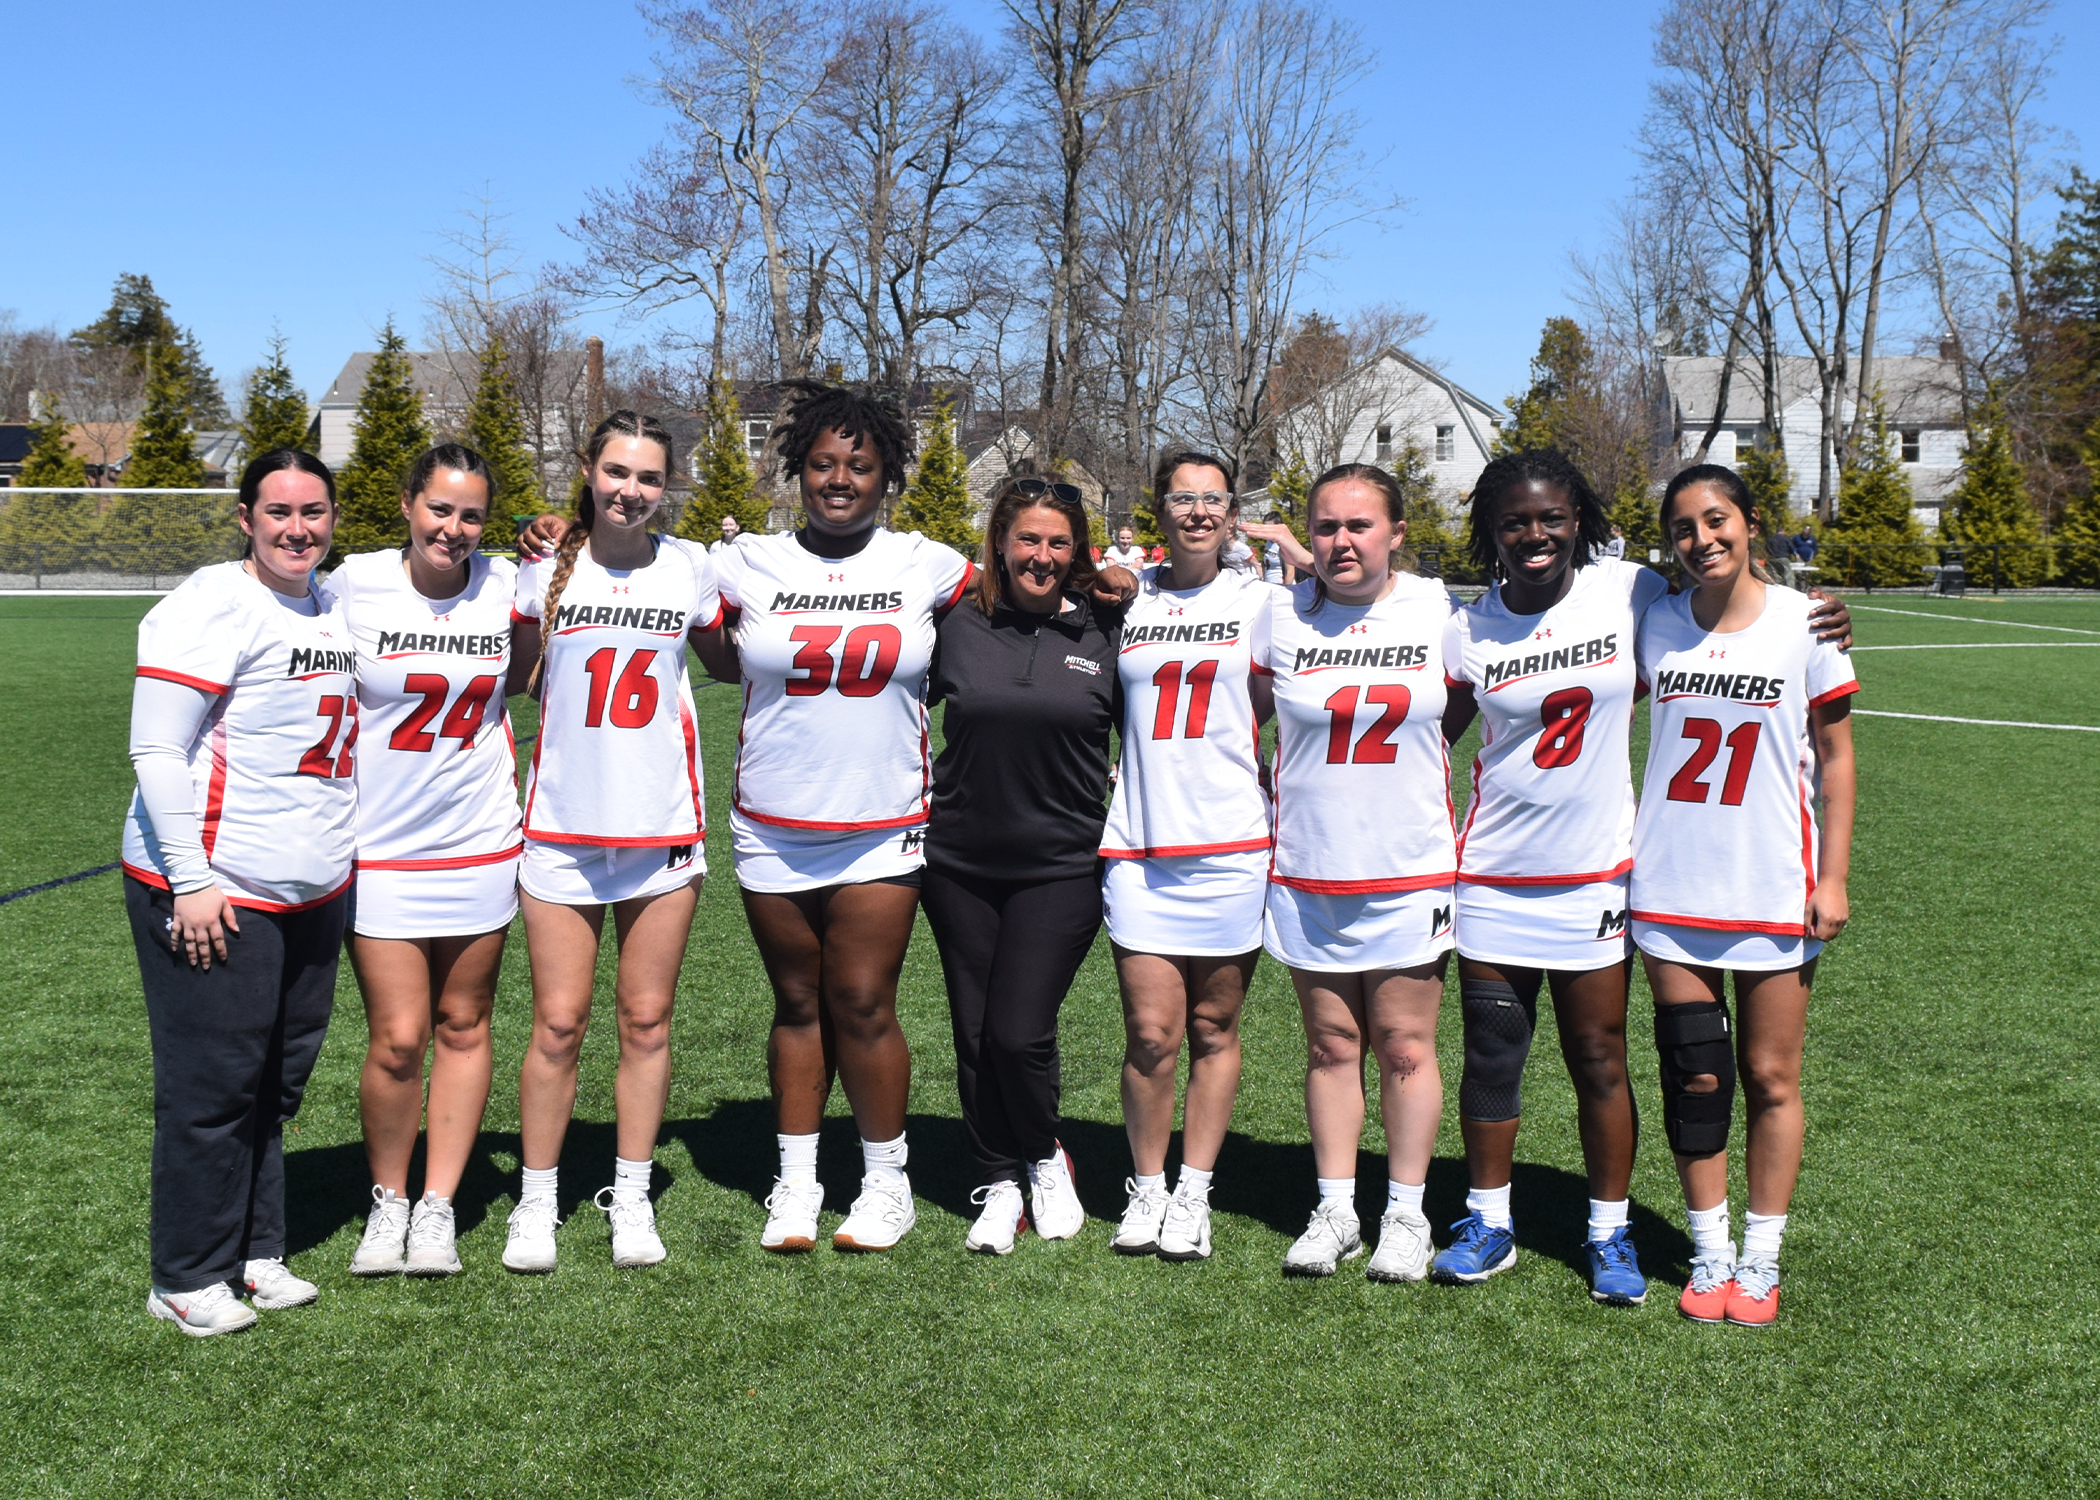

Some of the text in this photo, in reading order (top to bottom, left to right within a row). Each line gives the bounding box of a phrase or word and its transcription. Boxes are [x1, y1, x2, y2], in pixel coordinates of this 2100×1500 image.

[769, 591, 902, 612] MARINERS
[554, 604, 686, 632] MARINERS
[377, 631, 503, 656] MARINERS
[1120, 621, 1240, 649] MARINERS
[785, 624, 901, 697] 30
[1064, 654, 1100, 671] MITCHELL
[1293, 645, 1428, 672] MARINERS
[1484, 633, 1617, 690] MARINERS
[585, 647, 659, 729] 16
[1152, 660, 1219, 740] 11
[1656, 670, 1785, 701] MARINERS
[389, 673, 498, 752] 24
[1324, 684, 1411, 764] 12
[1533, 686, 1594, 770] 8
[295, 694, 360, 778] 22
[1667, 717, 1762, 806] 21
[667, 845, 692, 869] M
[901, 830, 921, 853] M
[1431, 904, 1451, 938] M
[1596, 910, 1626, 938] M
